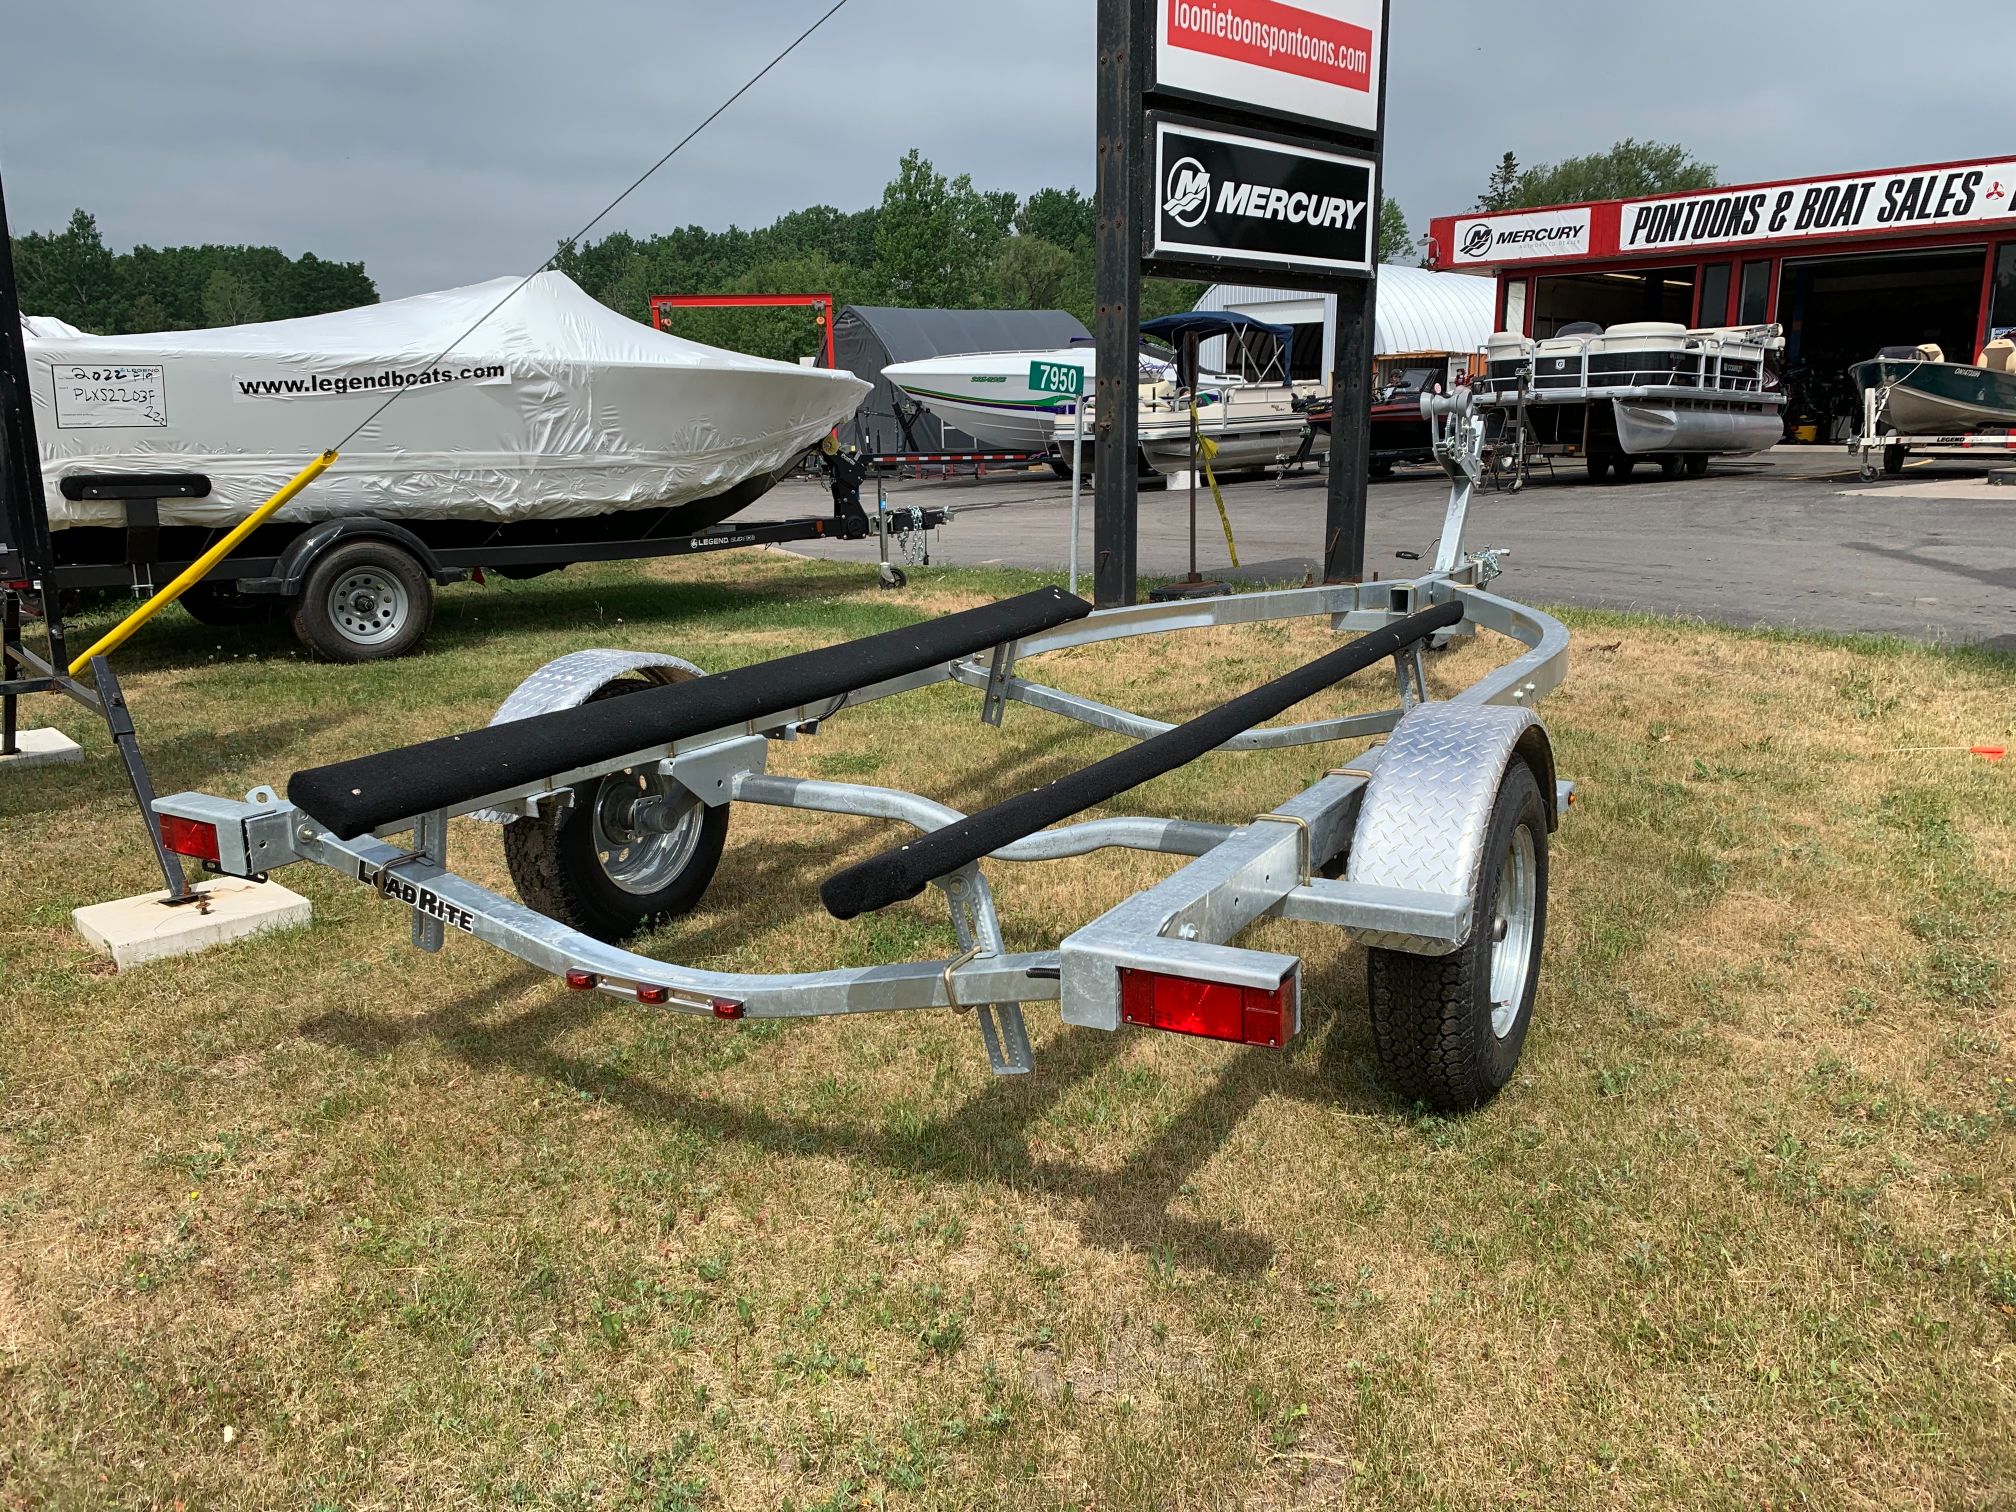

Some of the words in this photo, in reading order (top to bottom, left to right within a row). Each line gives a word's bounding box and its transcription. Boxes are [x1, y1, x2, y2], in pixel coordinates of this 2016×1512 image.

[1174, 0, 1367, 74] loonietoonspontoons.com
[1215, 180, 1367, 230] MERCURY
[1629, 193, 1765, 245] PONTOONS
[1768, 190, 1795, 233] &
[1794, 182, 1876, 231] BOAT
[1877, 171, 1984, 223] SALES
[1496, 225, 1585, 245] MERCURY
[72, 367, 127, 381] 2022
[239, 365, 505, 394] www.legendboats.com
[1040, 365, 1077, 393] 7950
[698, 537, 729, 546] LEGEND
